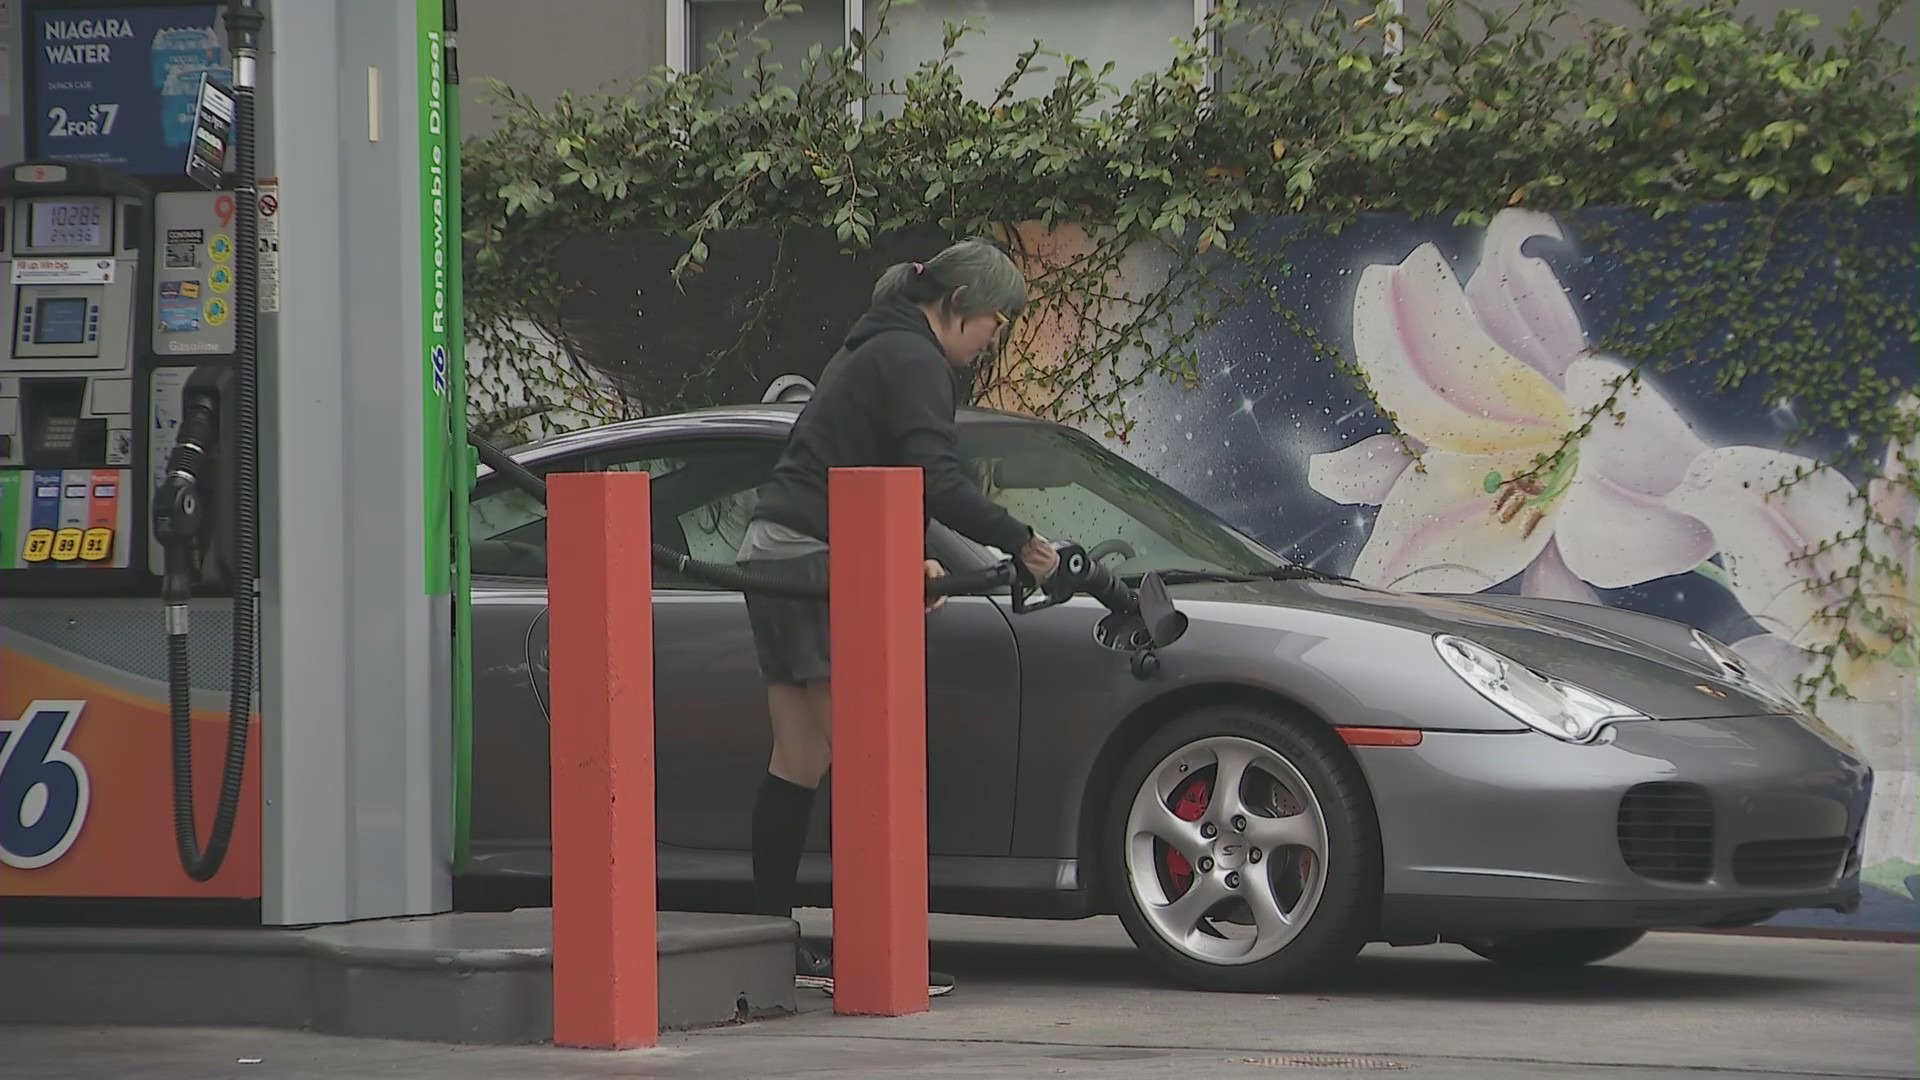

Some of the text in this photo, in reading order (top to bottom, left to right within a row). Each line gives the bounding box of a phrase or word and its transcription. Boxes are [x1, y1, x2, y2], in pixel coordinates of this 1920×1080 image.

[44, 19, 134, 40] NIAGARA
[46, 44, 111, 64] WATER
[48, 104, 119, 136] 2 FOR $7
[214, 195, 234, 228] 9
[428, 32, 446, 396] 76 Renewable Diesel
[169, 341, 218, 351] Gasoline
[30, 540, 46, 552] 87
[59, 539, 74, 552] 89
[87, 539, 102, 551] 91
[0, 700, 90, 869] 6
